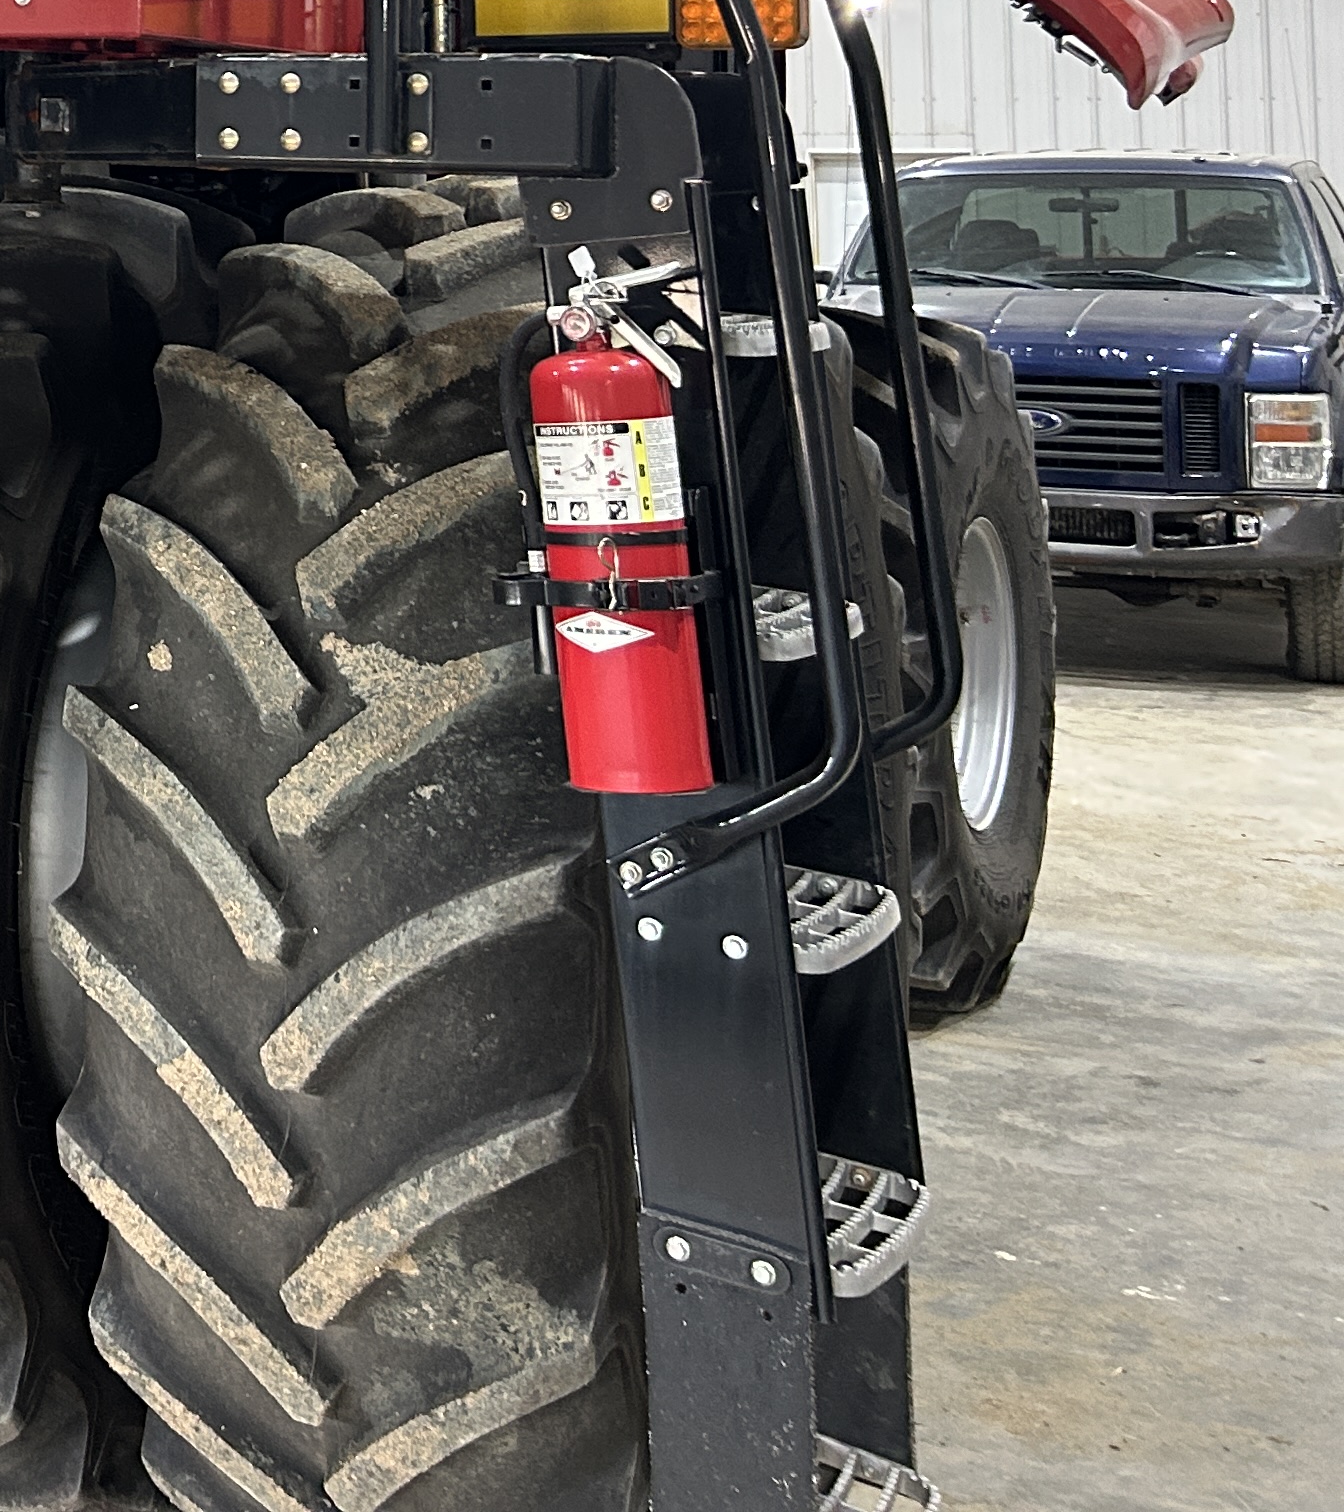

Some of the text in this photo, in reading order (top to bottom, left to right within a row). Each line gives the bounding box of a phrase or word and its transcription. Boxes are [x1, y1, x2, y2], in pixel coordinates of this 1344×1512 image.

[539, 424, 614, 436] INSTRUCTONS
[635, 430, 643, 445] A
[638, 463, 646, 478] B
[642, 496, 650, 511] C
